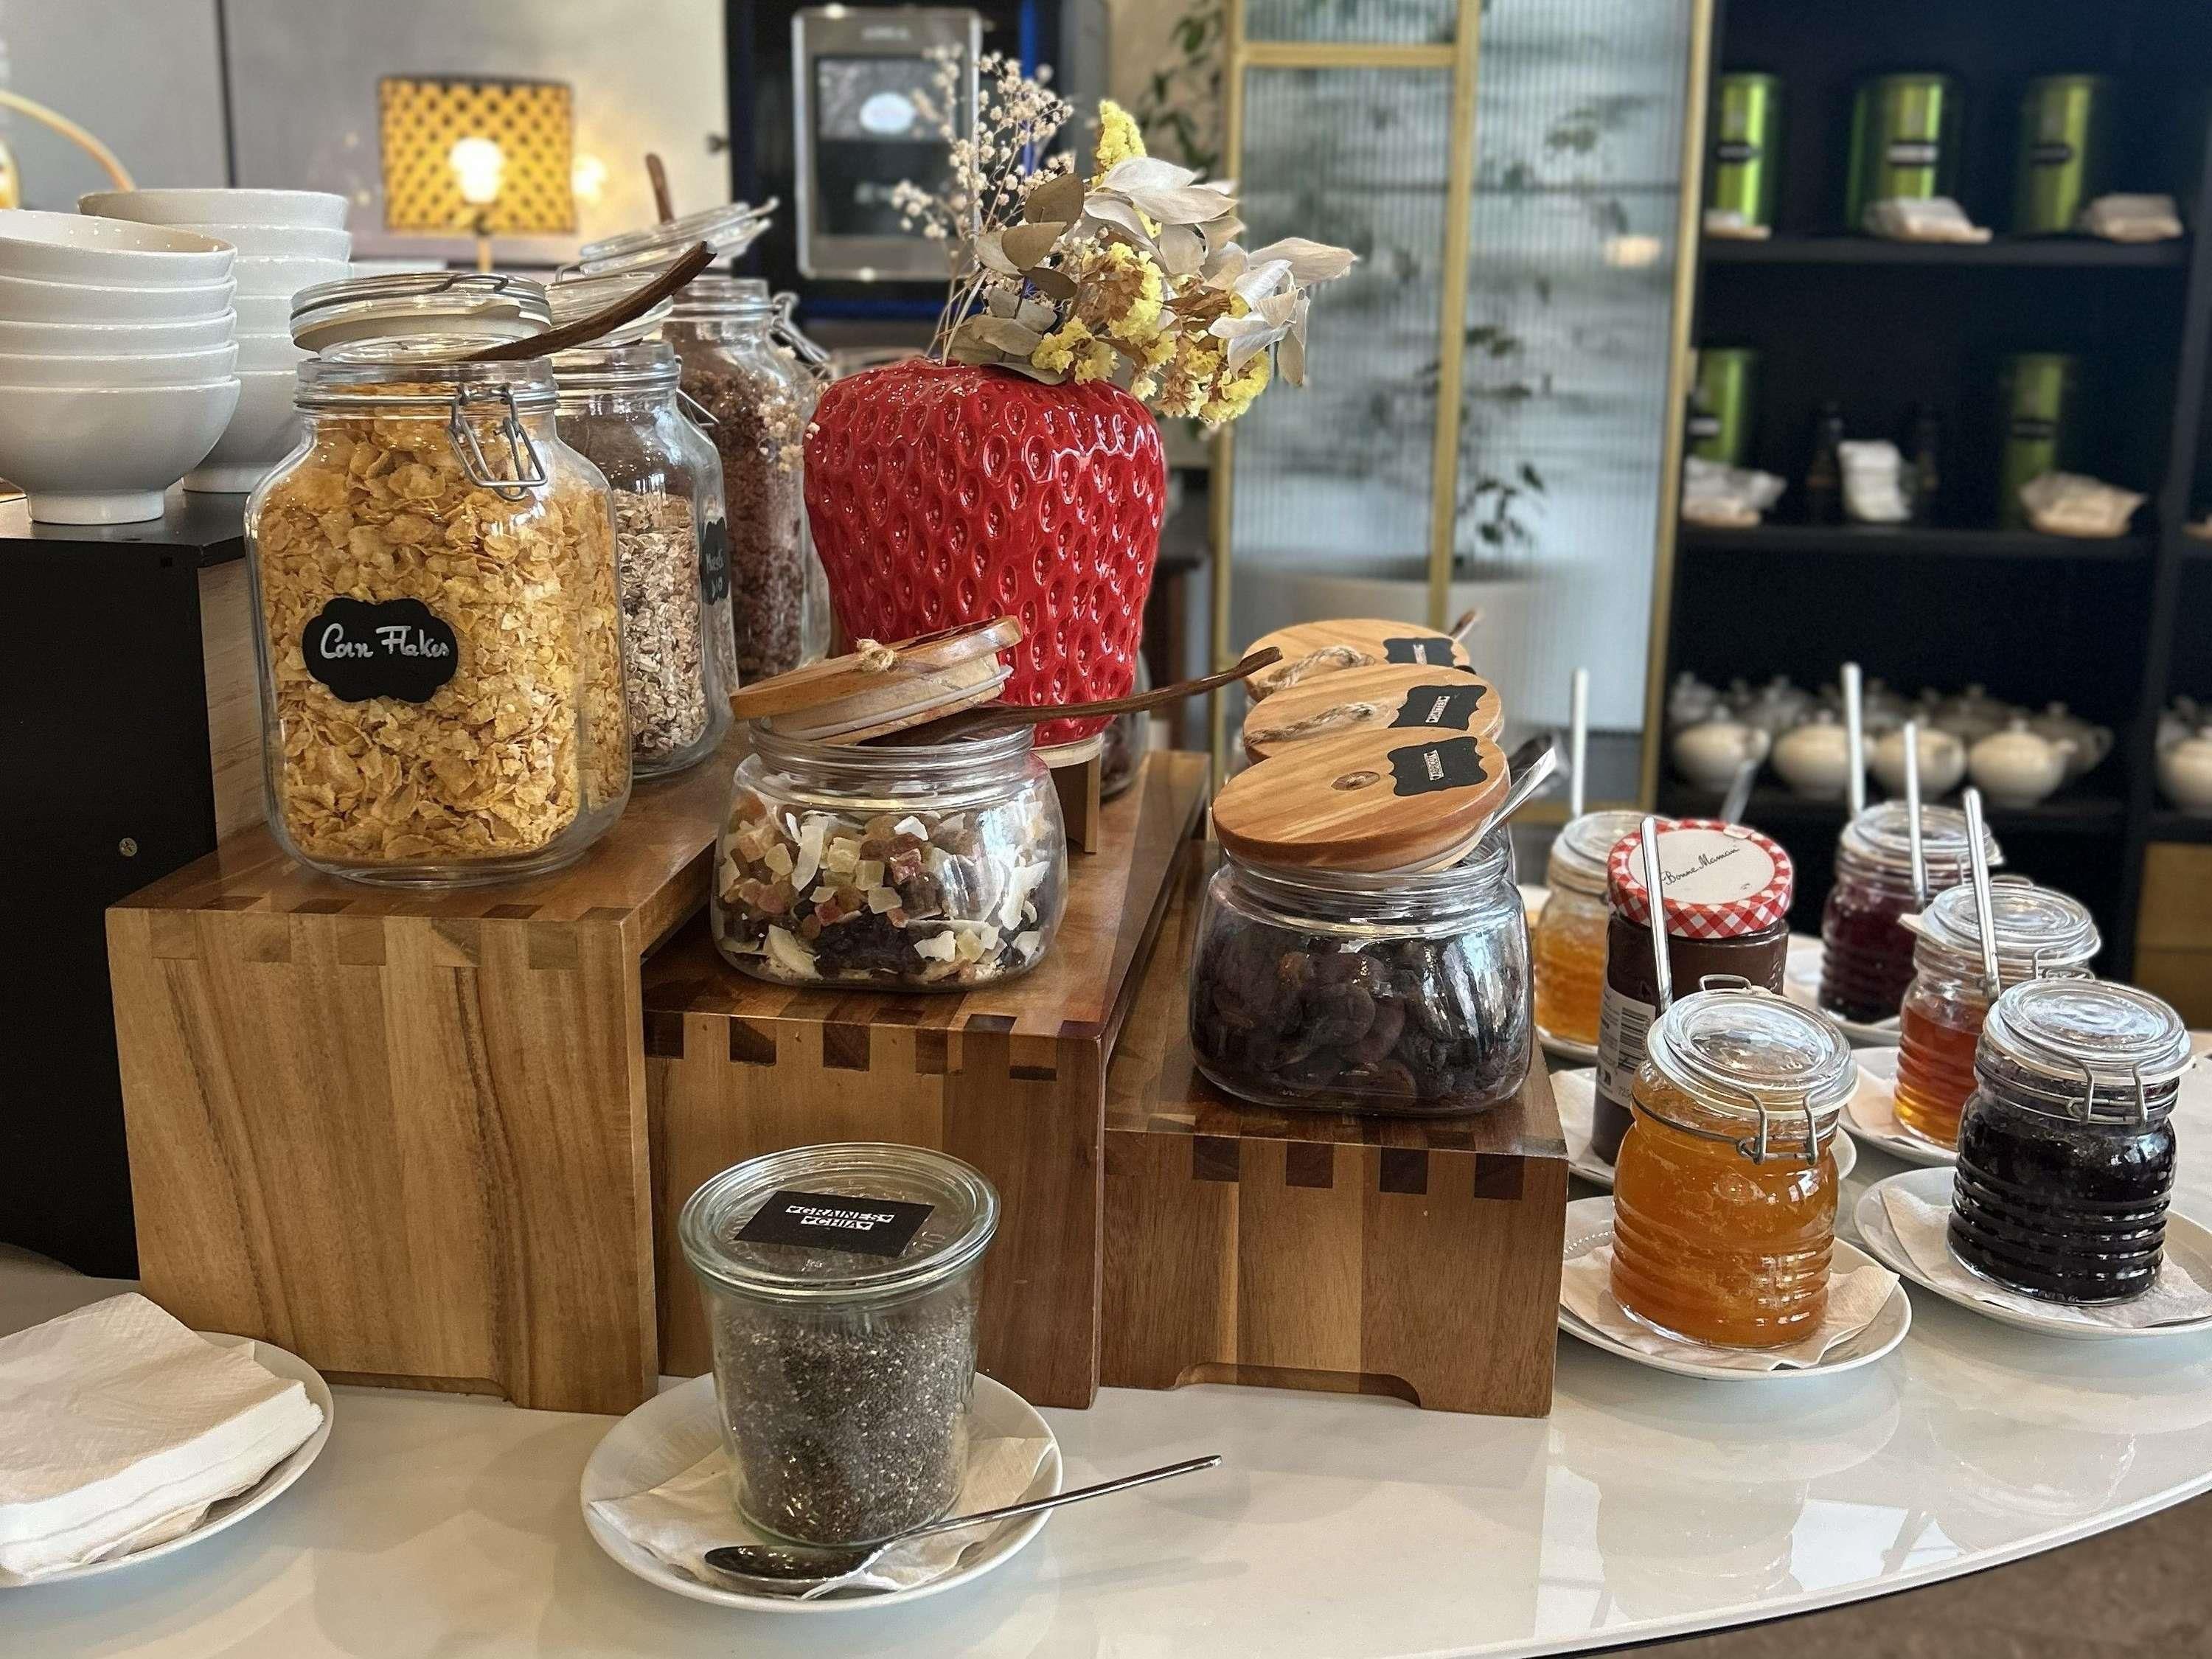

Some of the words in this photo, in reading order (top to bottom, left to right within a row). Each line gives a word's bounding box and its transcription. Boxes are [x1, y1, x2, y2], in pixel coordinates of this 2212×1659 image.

[320, 622, 374, 659] Corn
[375, 625, 450, 658] Flakes
[1660, 867, 1699, 886] Bonne
[1698, 848, 1740, 869] Maman
[799, 1206, 879, 1222] GRAINES
[815, 1216, 858, 1228] CHIA
